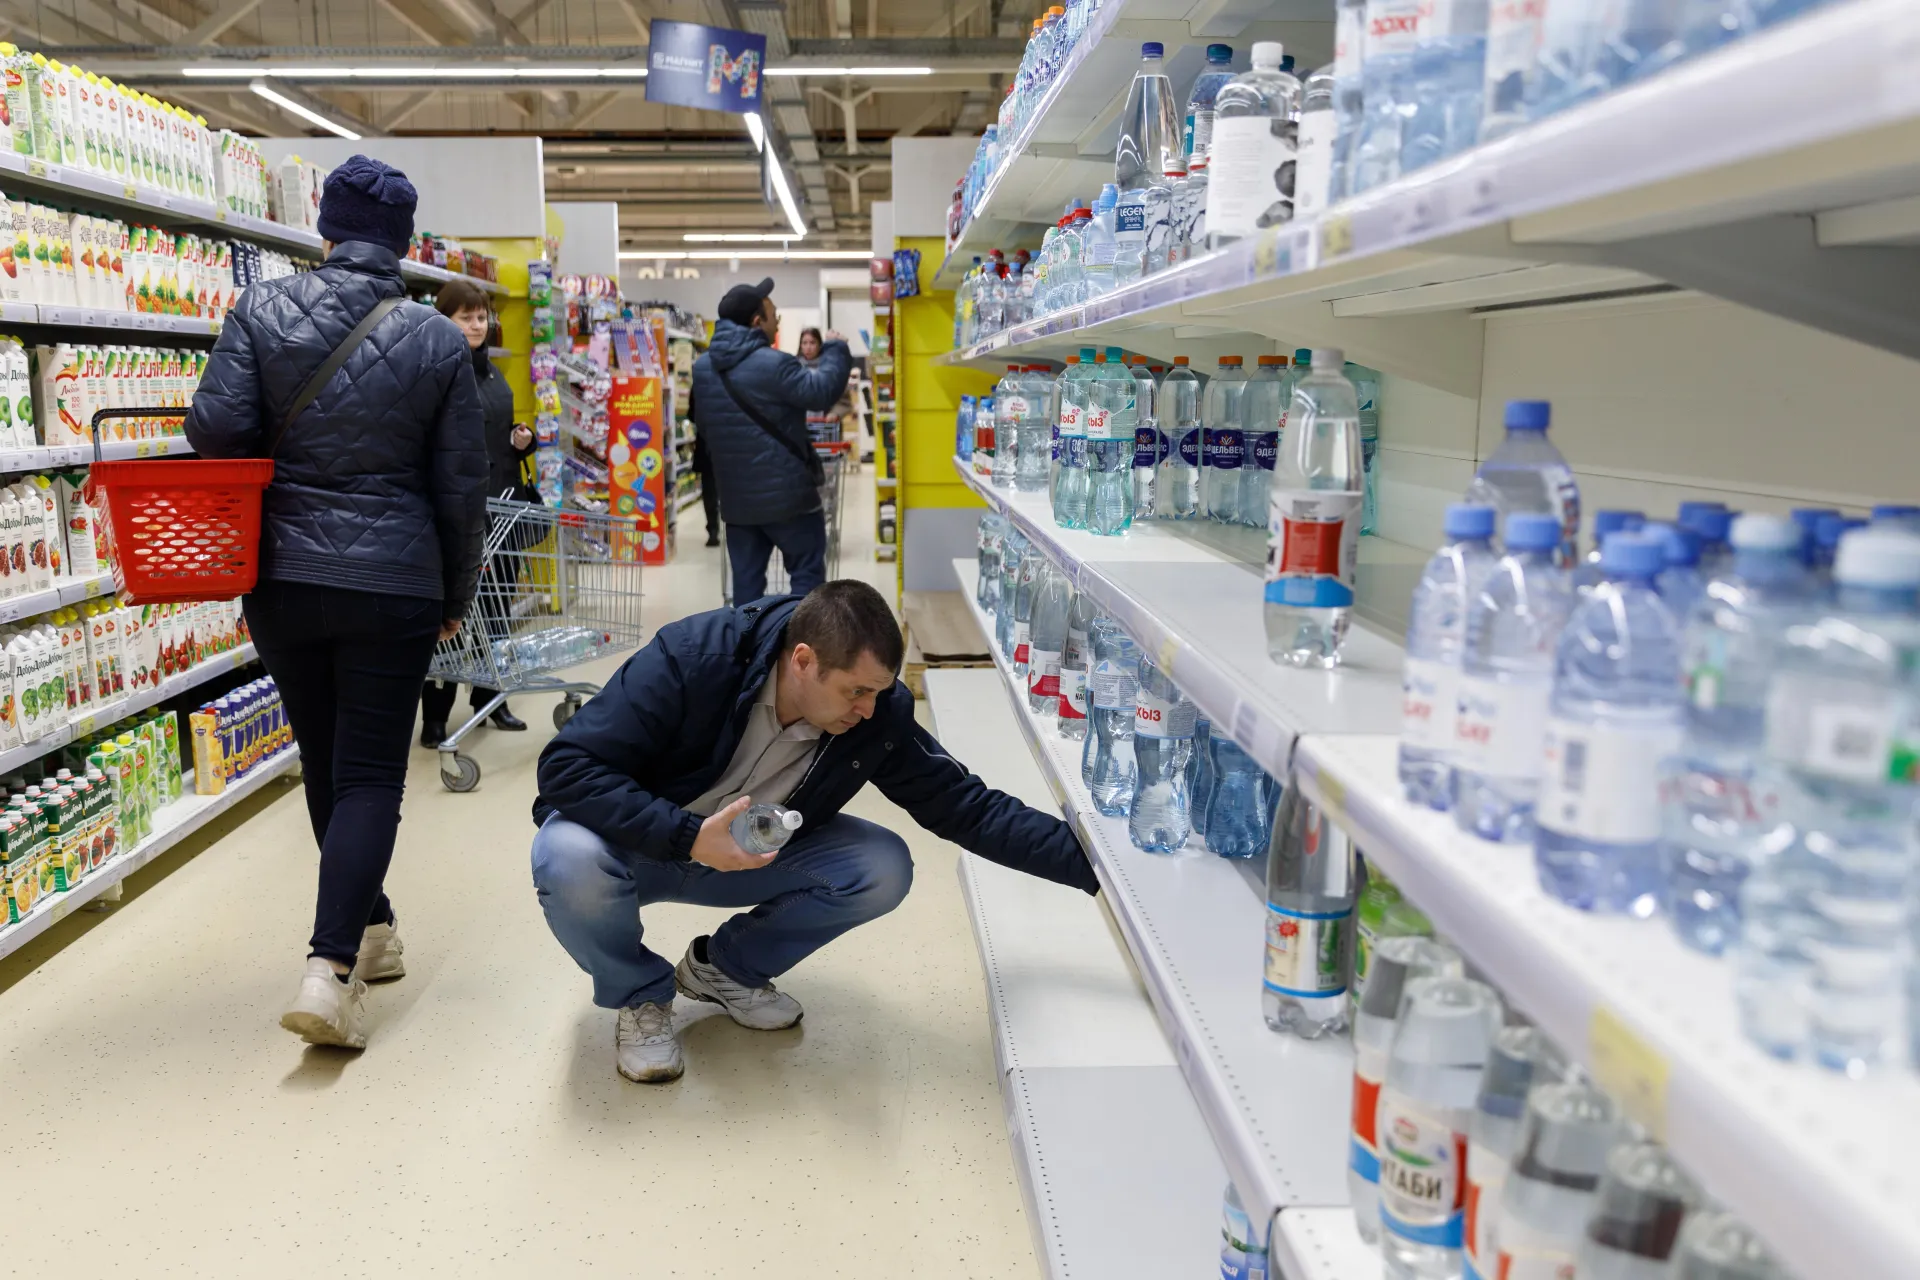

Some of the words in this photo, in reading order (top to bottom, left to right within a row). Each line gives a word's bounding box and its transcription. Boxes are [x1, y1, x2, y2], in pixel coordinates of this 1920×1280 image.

[1119, 206, 1146, 217] LEGEN
[10, 369, 31, 382] Добры
[23, 515, 43, 527] Добры
[16, 664, 36, 679] Добры
